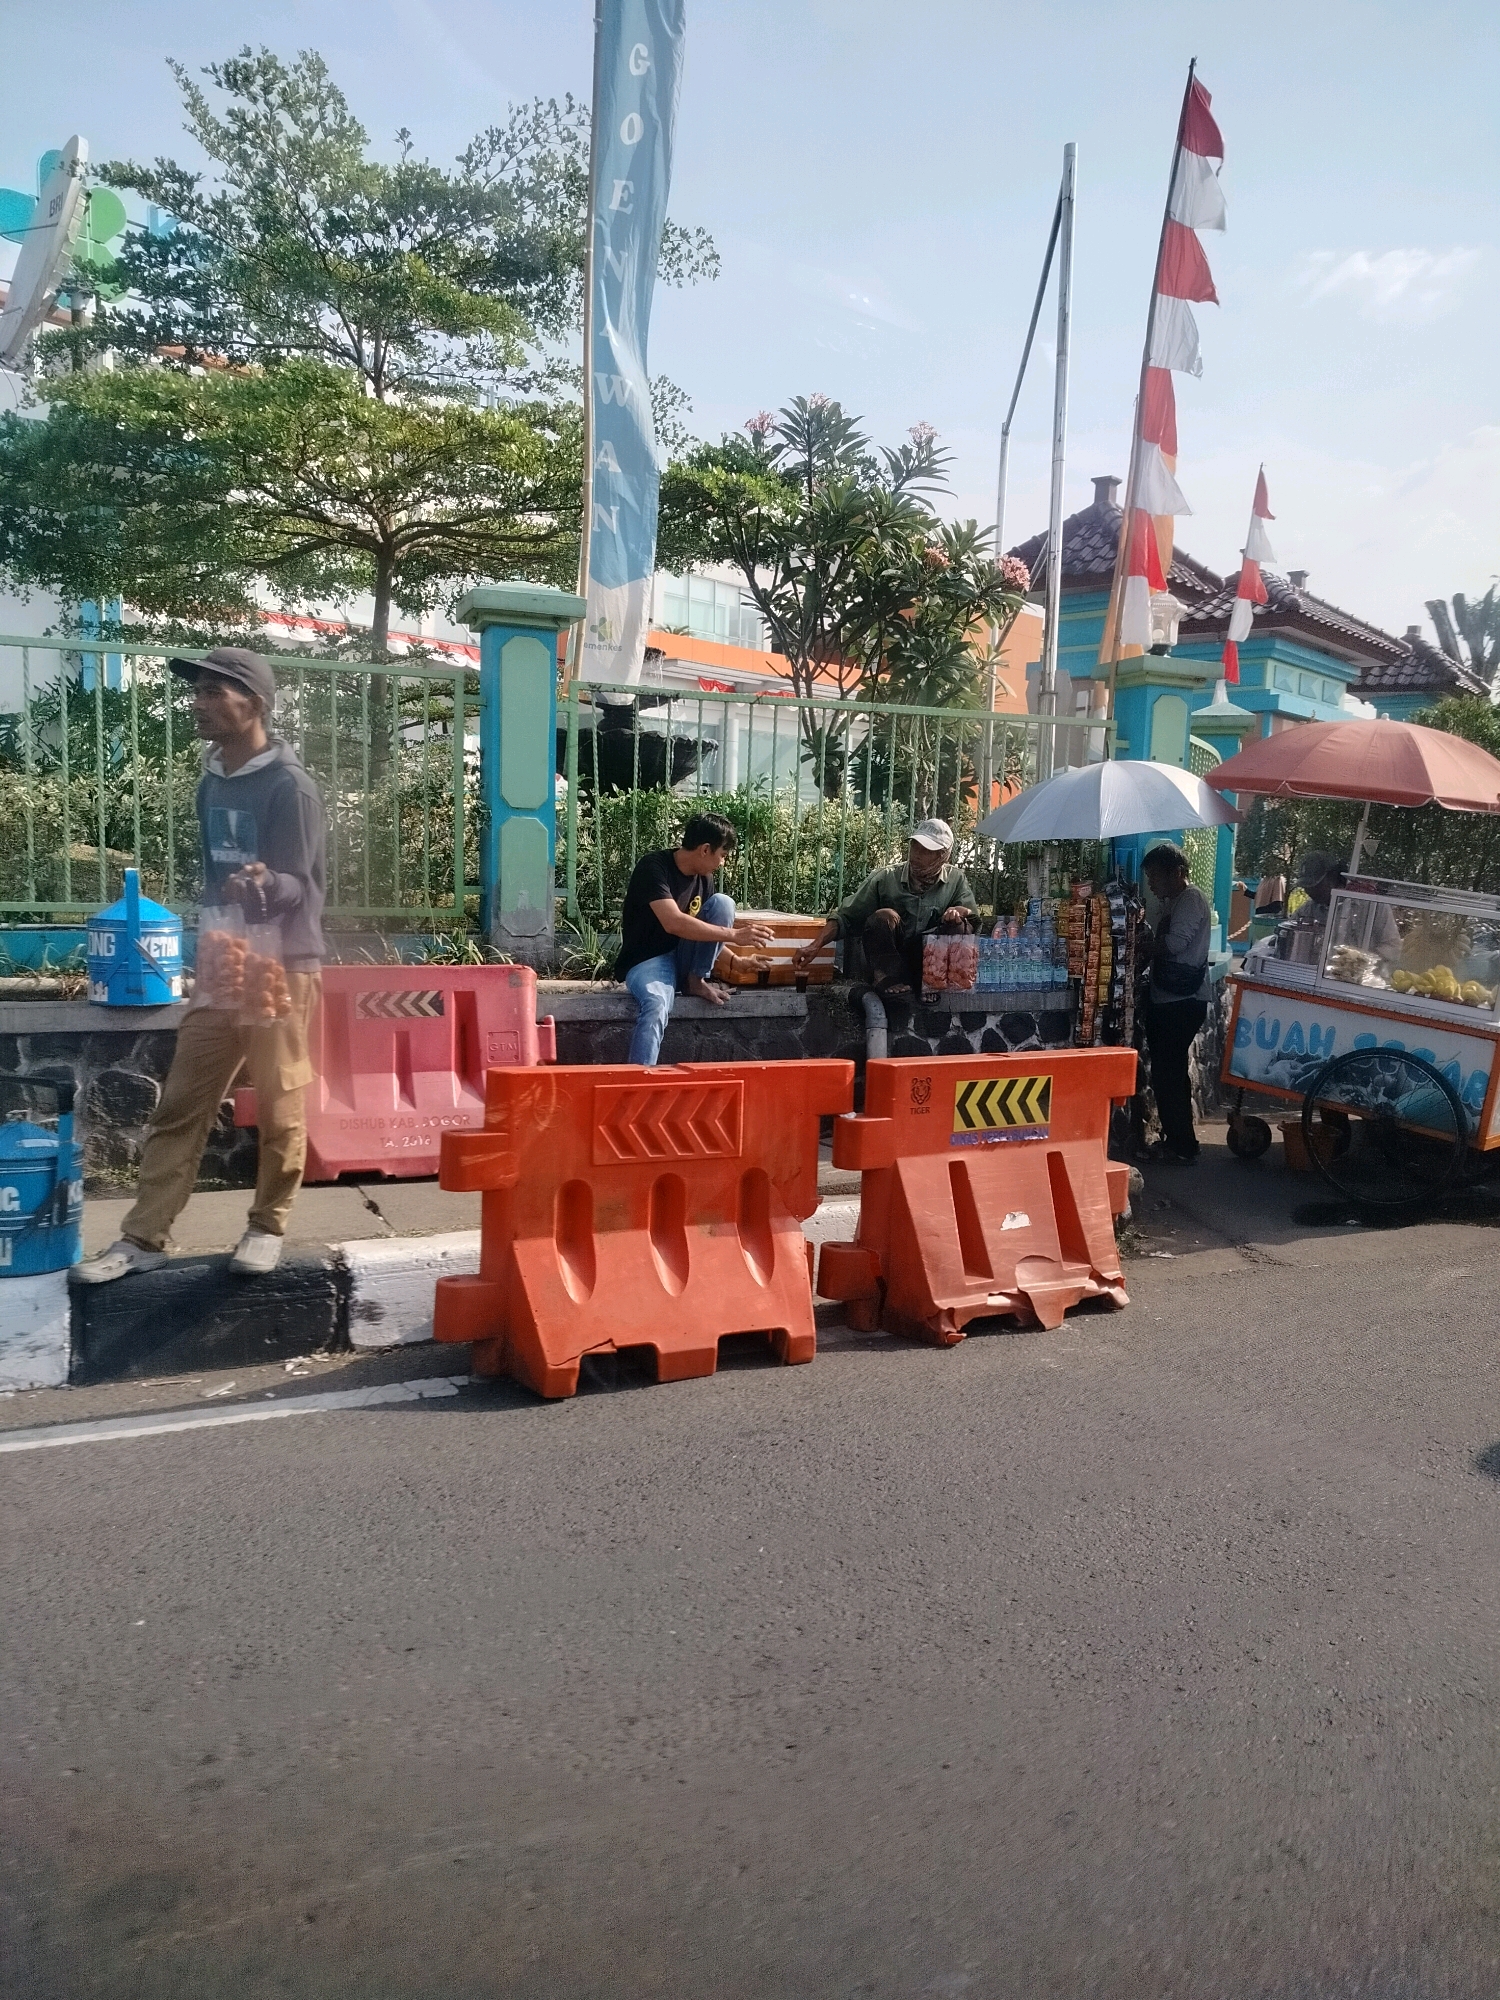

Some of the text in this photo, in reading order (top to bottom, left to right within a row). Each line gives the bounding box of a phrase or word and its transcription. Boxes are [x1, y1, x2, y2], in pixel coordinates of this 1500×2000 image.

[49, 192, 63, 218] BRI
[584, 641, 623, 652] emenkes
[140, 935, 179, 957] KETAN
[1233, 1017, 1337, 1057] BUAH
[490, 1043, 517, 1052] GTM
[910, 1106, 931, 1115] TIGER
[339, 1114, 471, 1130] DISHUB KAB. BOGOR
